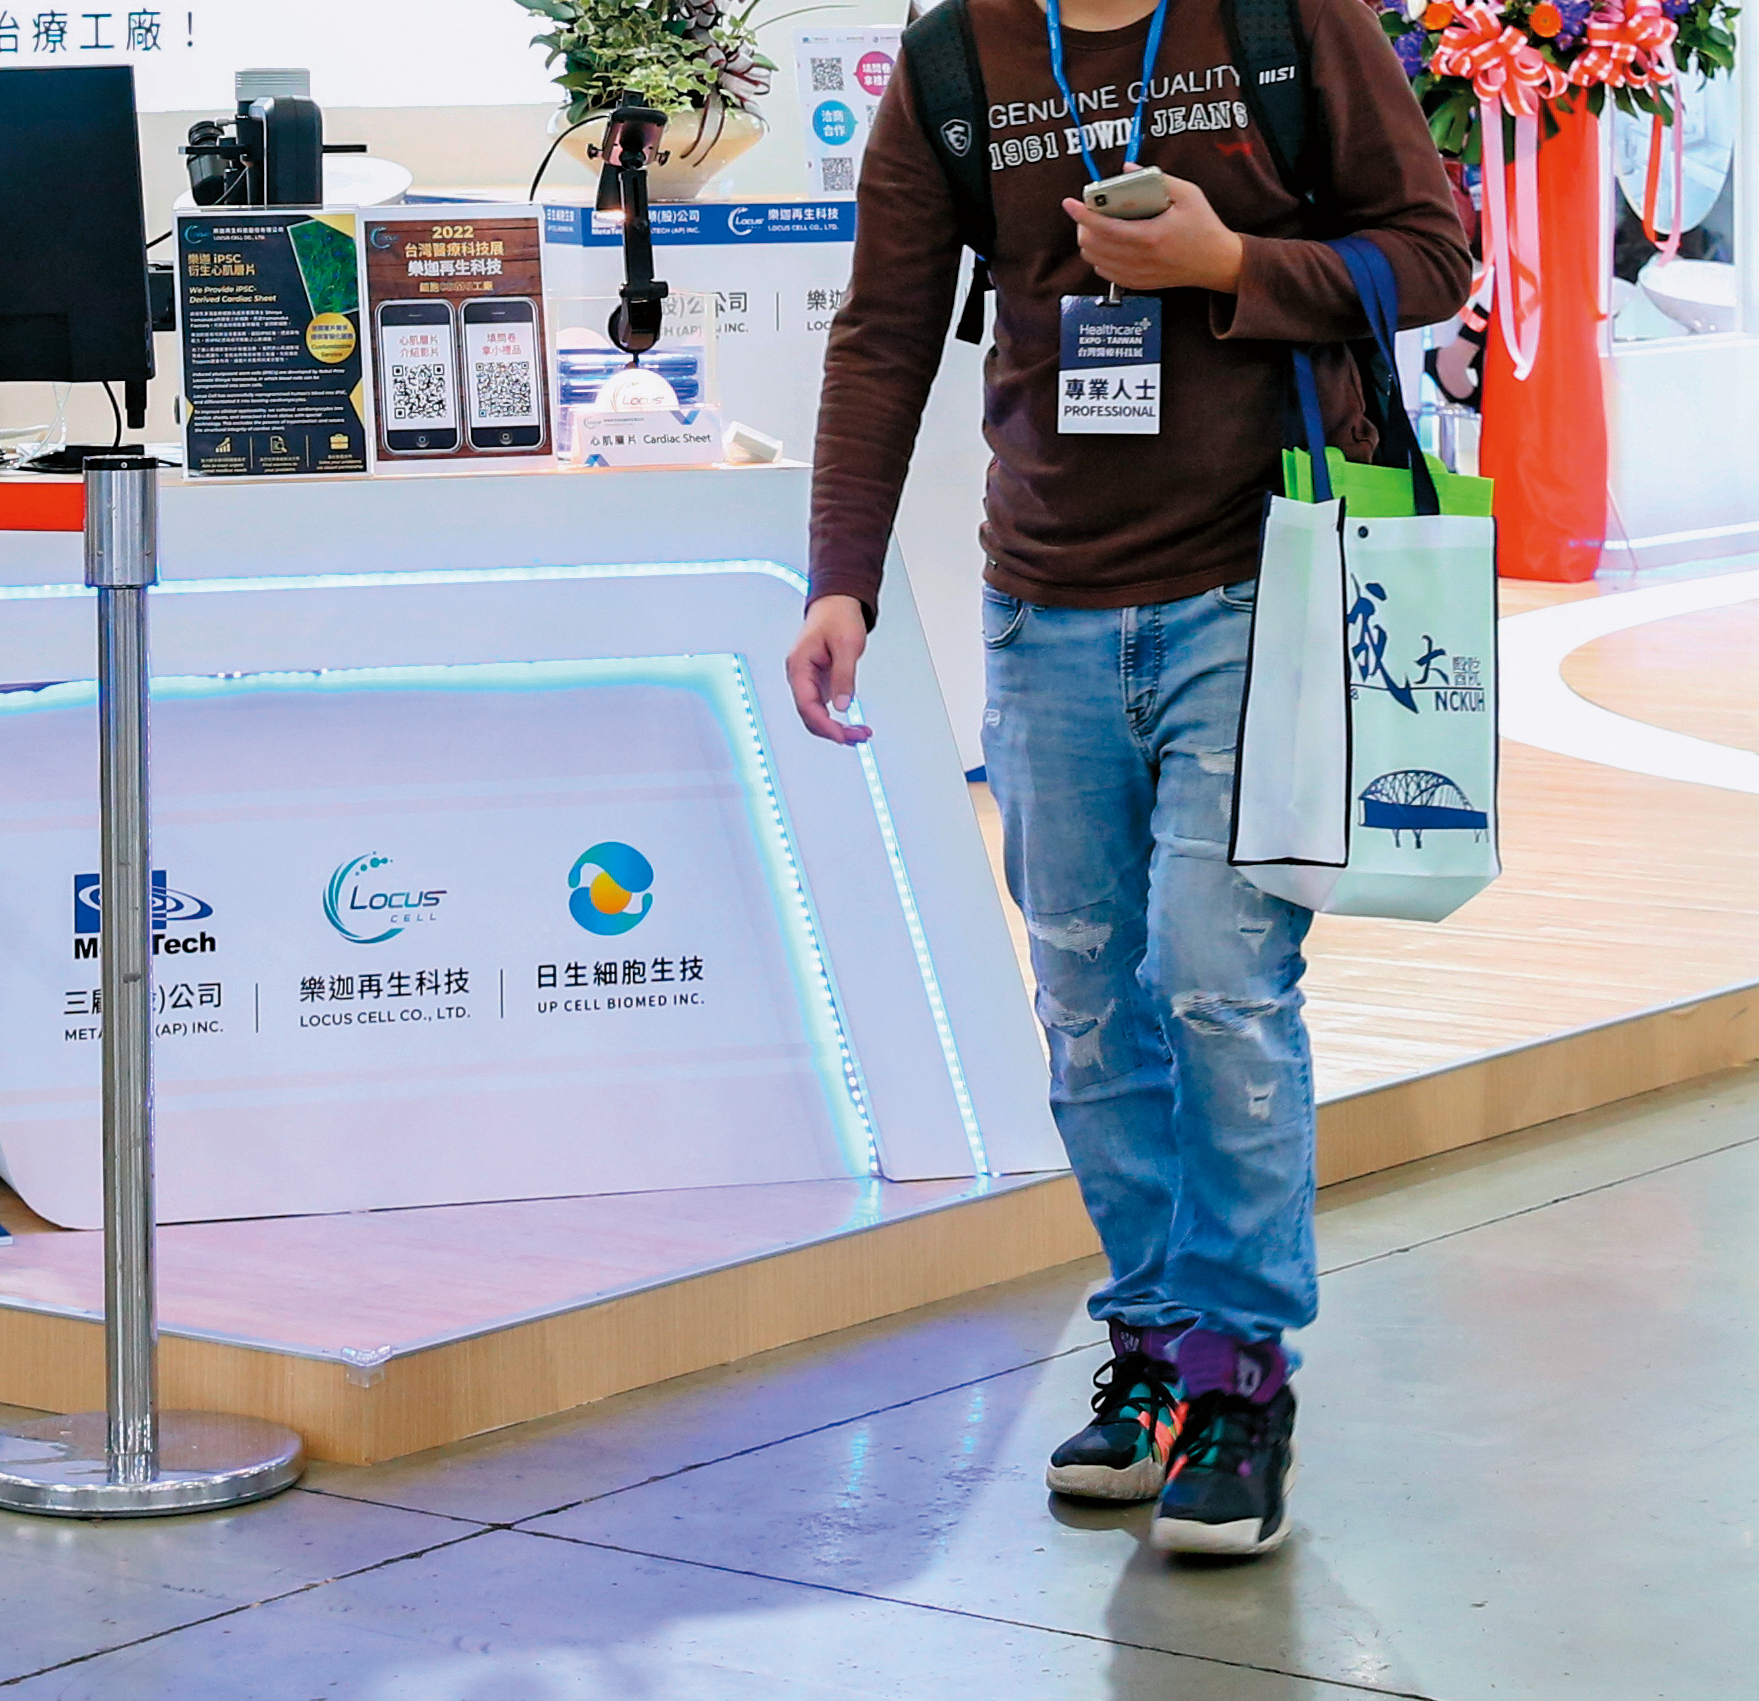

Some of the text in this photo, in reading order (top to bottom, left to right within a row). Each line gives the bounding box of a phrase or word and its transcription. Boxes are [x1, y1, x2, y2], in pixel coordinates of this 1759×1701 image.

[989, 131, 1059, 171] 1961
[1150, 100, 1249, 138] JEANS
[768, 208, 839, 221] 樂迦再生科技
[432, 226, 474, 239] 2022
[214, 253, 241, 263] iPSC
[405, 241, 504, 258] 台灣醫療科技展
[407, 260, 503, 277] 樂迦再生科技
[254, 294, 276, 302] Sheet
[806, 321, 831, 332] LOC
[1079, 324, 1142, 335] Healthcare
[1065, 378, 1156, 401] 專業人士
[1064, 405, 1156, 417] PROFESSIONAL
[643, 435, 681, 444] Cardiac
[682, 433, 712, 443] Sheet
[1435, 691, 1485, 712] NCKUH
[390, 913, 437, 923] CELL
[74, 932, 216, 960] MTech
[538, 955, 704, 988] 日生細胞生技
[299, 967, 470, 1002] 樂迦再生科技
[538, 993, 705, 1013] UP CELL BIOMED INC.
[300, 1013, 353, 1027] LOCUS
[357, 1010, 395, 1024] CELL
[437, 1006, 470, 1019] LTD.
[155, 1020, 223, 1037] (AP) INC.
